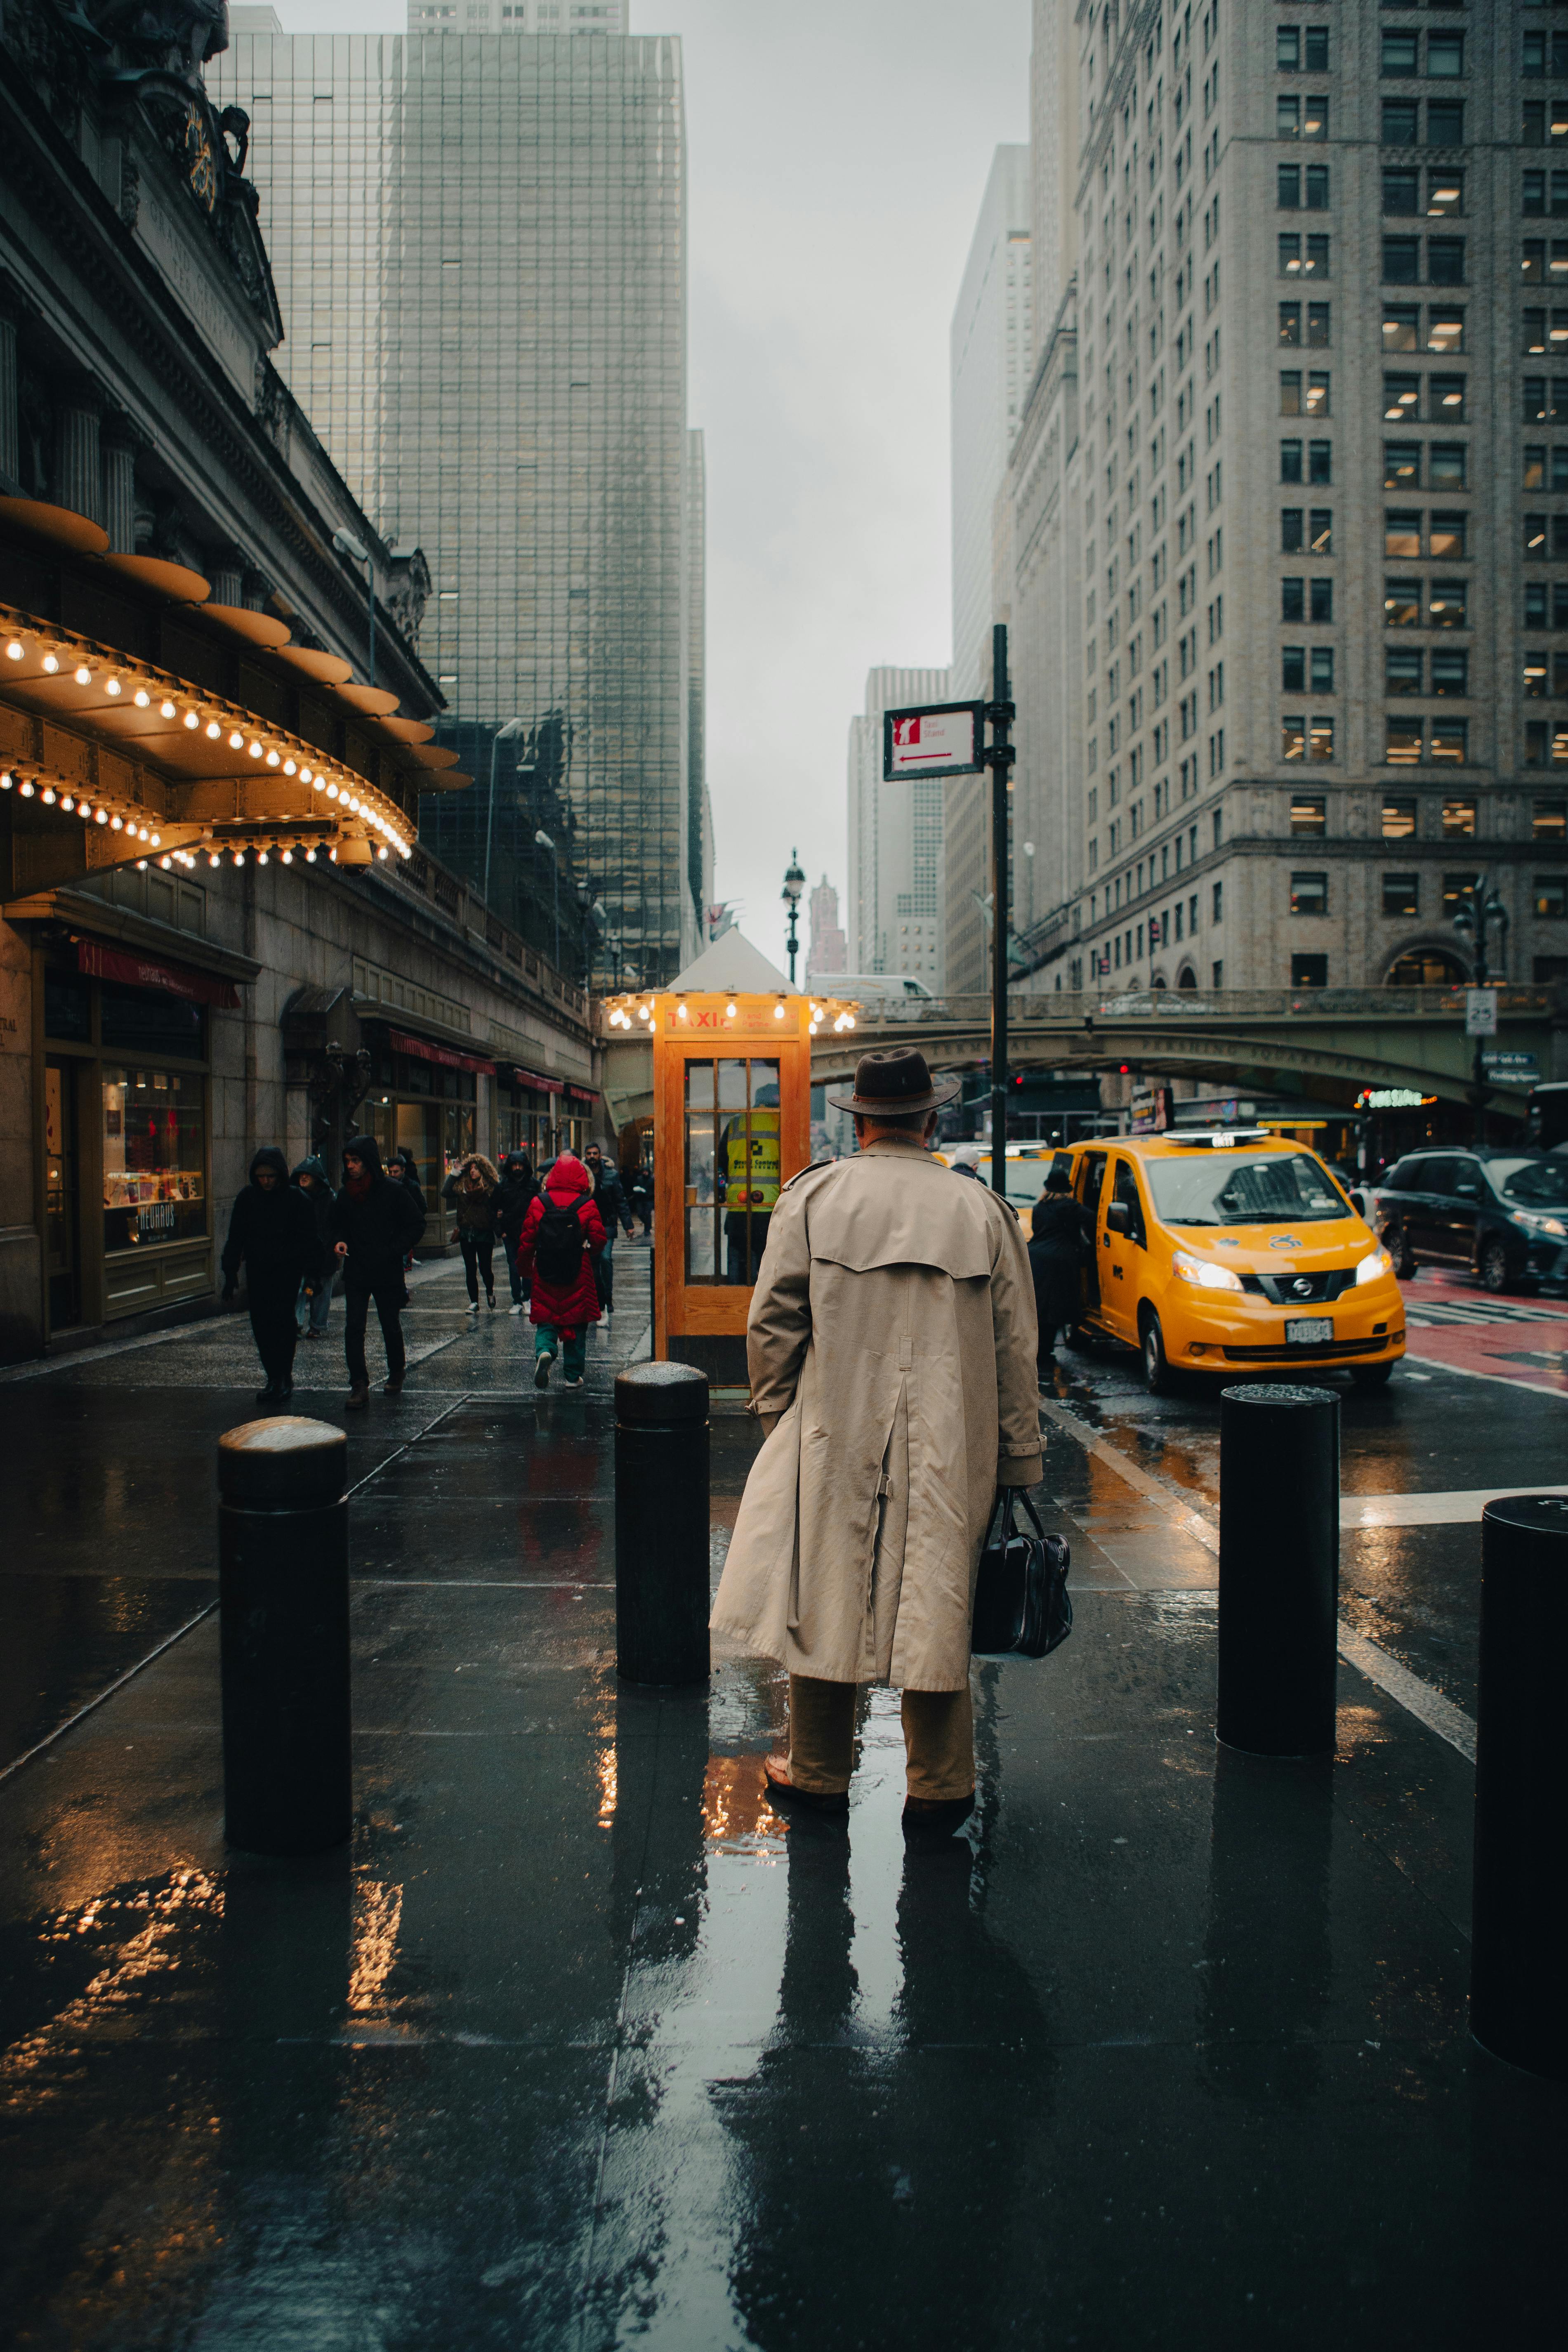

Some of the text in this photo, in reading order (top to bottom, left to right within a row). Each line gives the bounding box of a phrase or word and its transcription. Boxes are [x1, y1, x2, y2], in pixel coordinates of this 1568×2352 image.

[924, 720, 938, 729] Taxi
[923, 729, 945, 738] Stand
[1471, 1008, 1491, 1020] 25
[140, 1203, 174, 1231] NEUHAUS
